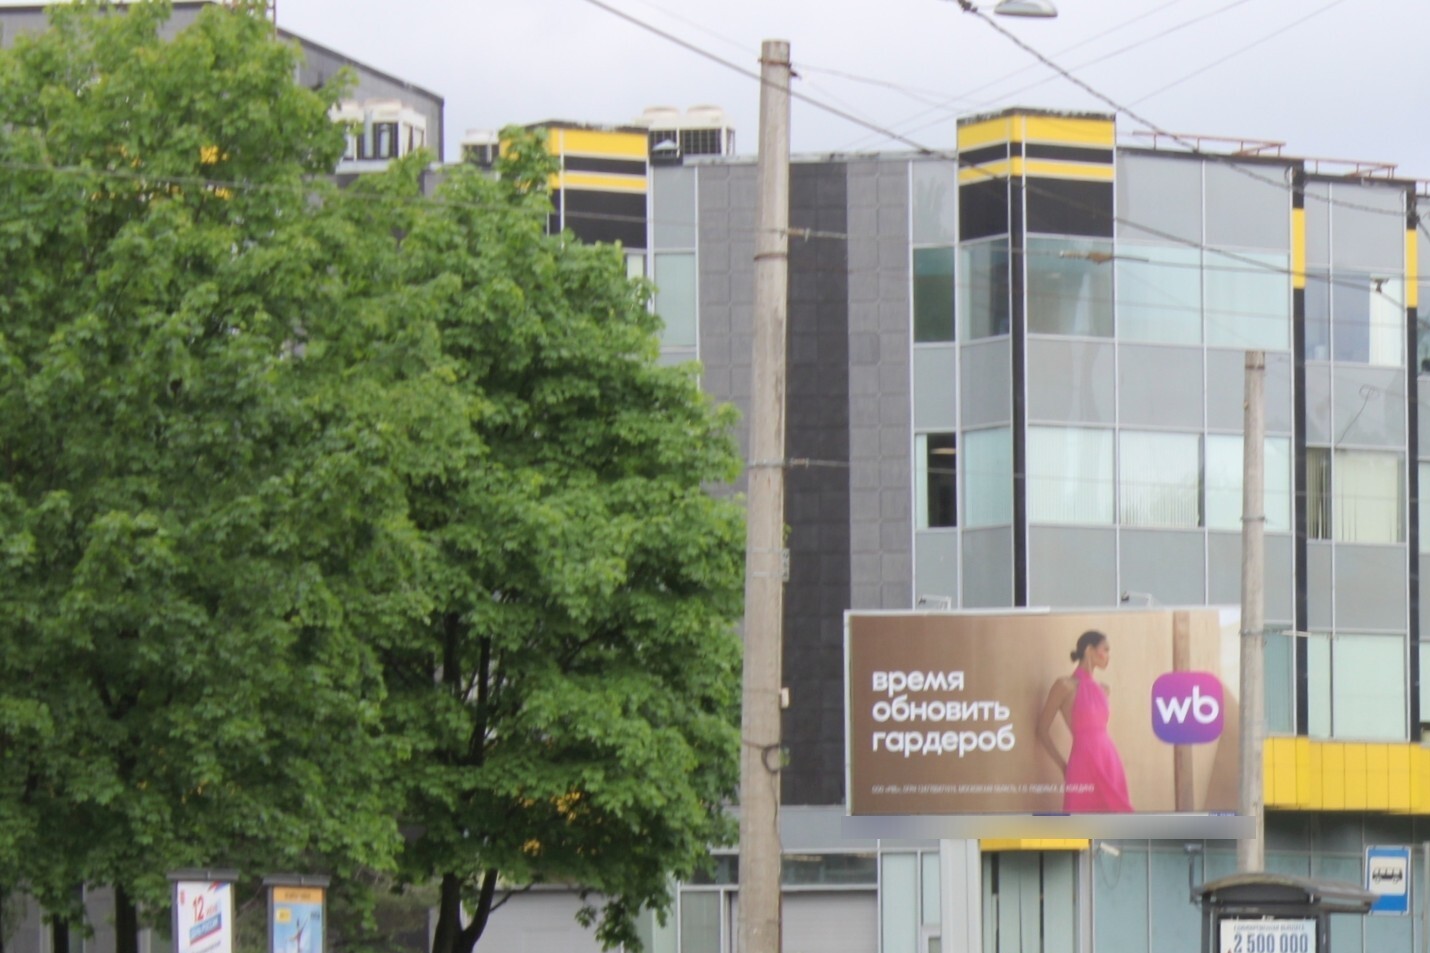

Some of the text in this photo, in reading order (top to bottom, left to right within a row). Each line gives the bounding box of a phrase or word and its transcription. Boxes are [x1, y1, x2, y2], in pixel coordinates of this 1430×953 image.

[872, 670, 965, 697] время
[872, 694, 1011, 723] обновить
[1155, 685, 1220, 725] wb
[872, 725, 1015, 758] гардероб
[1234, 933, 1308, 953] 2 500 000
